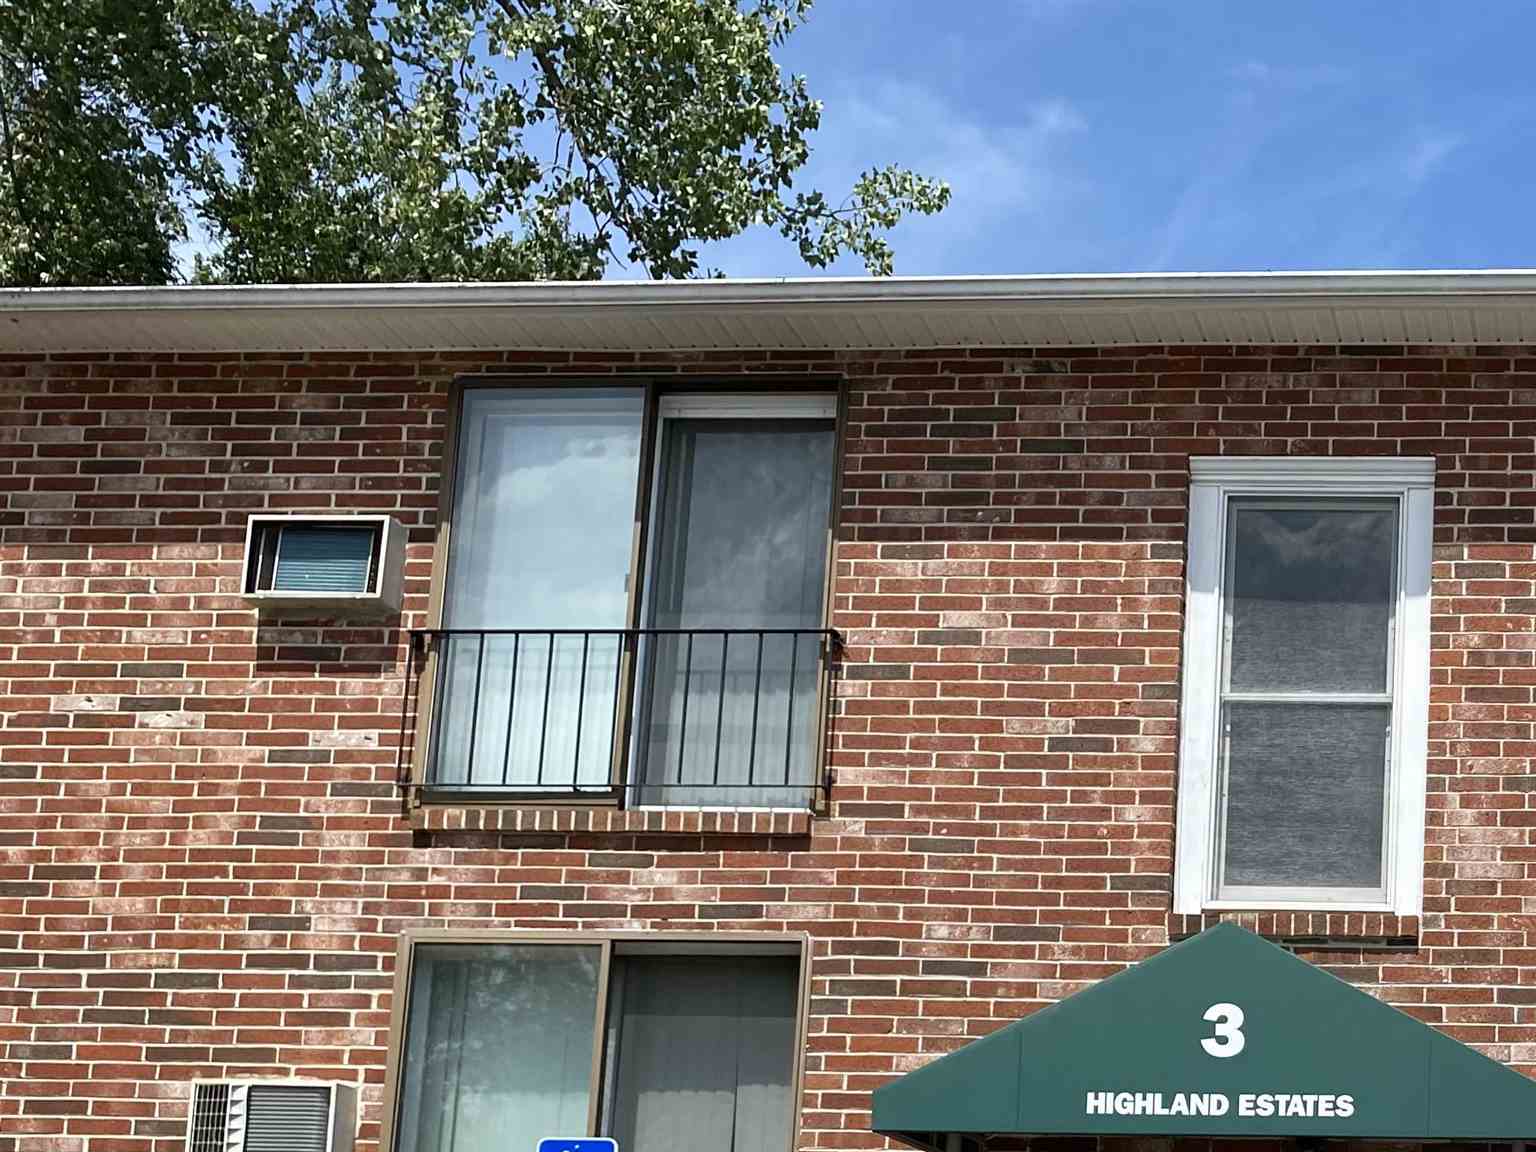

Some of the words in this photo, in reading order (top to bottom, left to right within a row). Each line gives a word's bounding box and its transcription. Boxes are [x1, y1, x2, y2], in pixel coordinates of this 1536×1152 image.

[1200, 1002, 1246, 1058] 3
[1086, 1092, 1230, 1117] HIGHLAND
[1238, 1094, 1355, 1118] ESTATES
